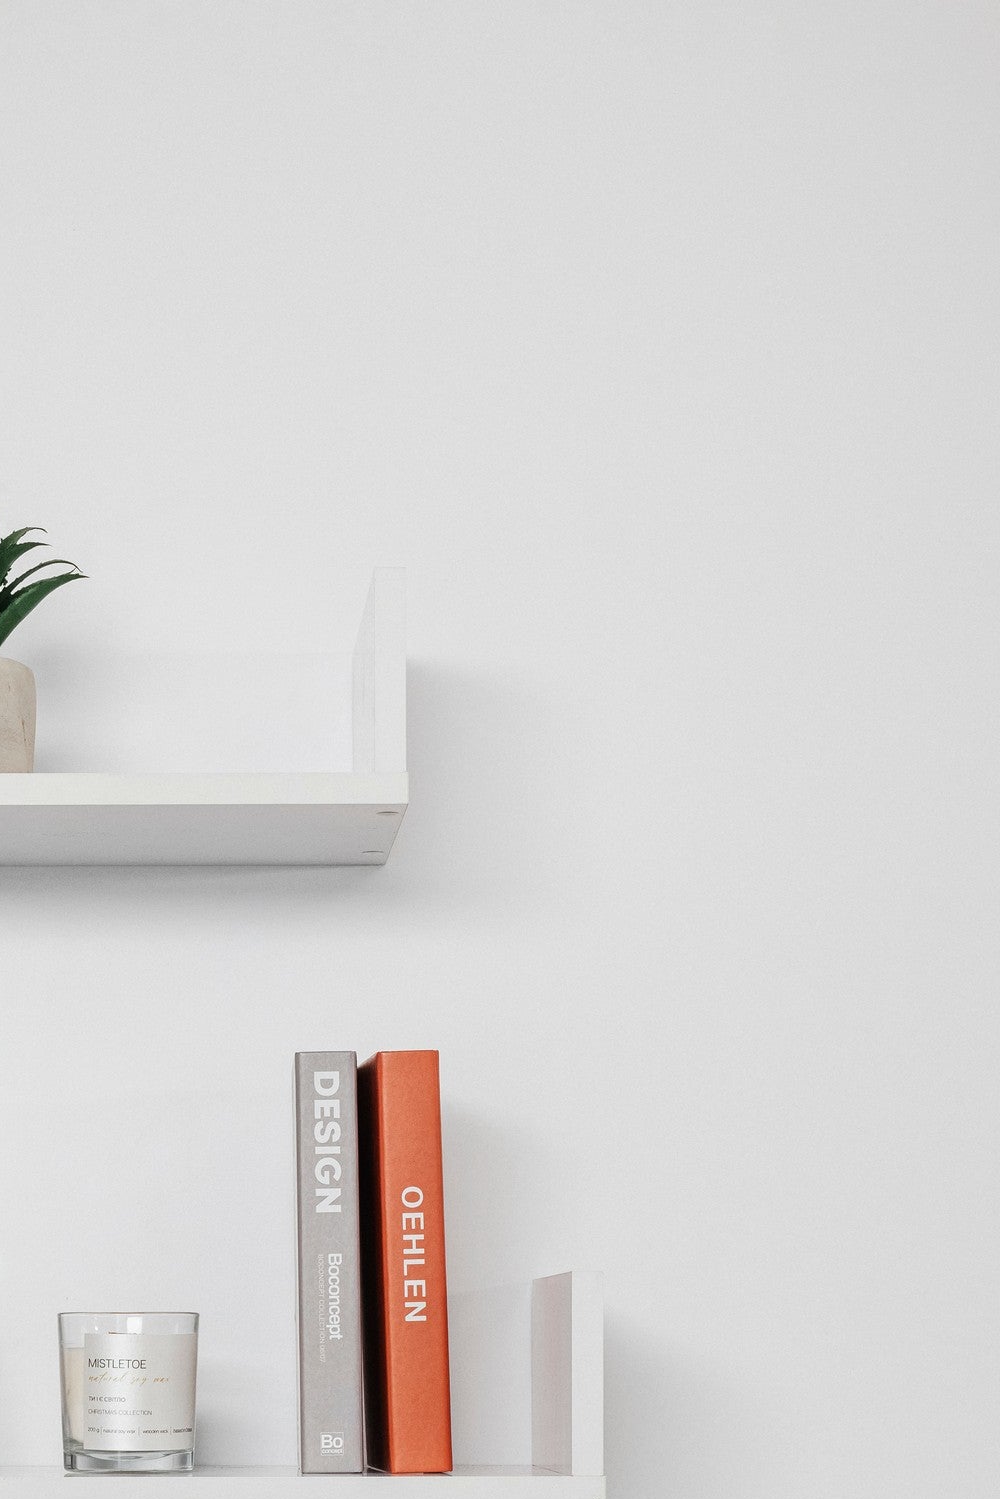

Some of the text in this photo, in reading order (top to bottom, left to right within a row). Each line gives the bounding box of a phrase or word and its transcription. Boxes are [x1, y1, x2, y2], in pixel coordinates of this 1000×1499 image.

[314, 1070, 342, 1213] DESIGN
[326, 1253, 343, 1340] Boconcept
[401, 1186, 427, 1322] OEHLEN
[88, 1358, 147, 1370] MISTLETOE
[321, 1434, 343, 1449] Bo
